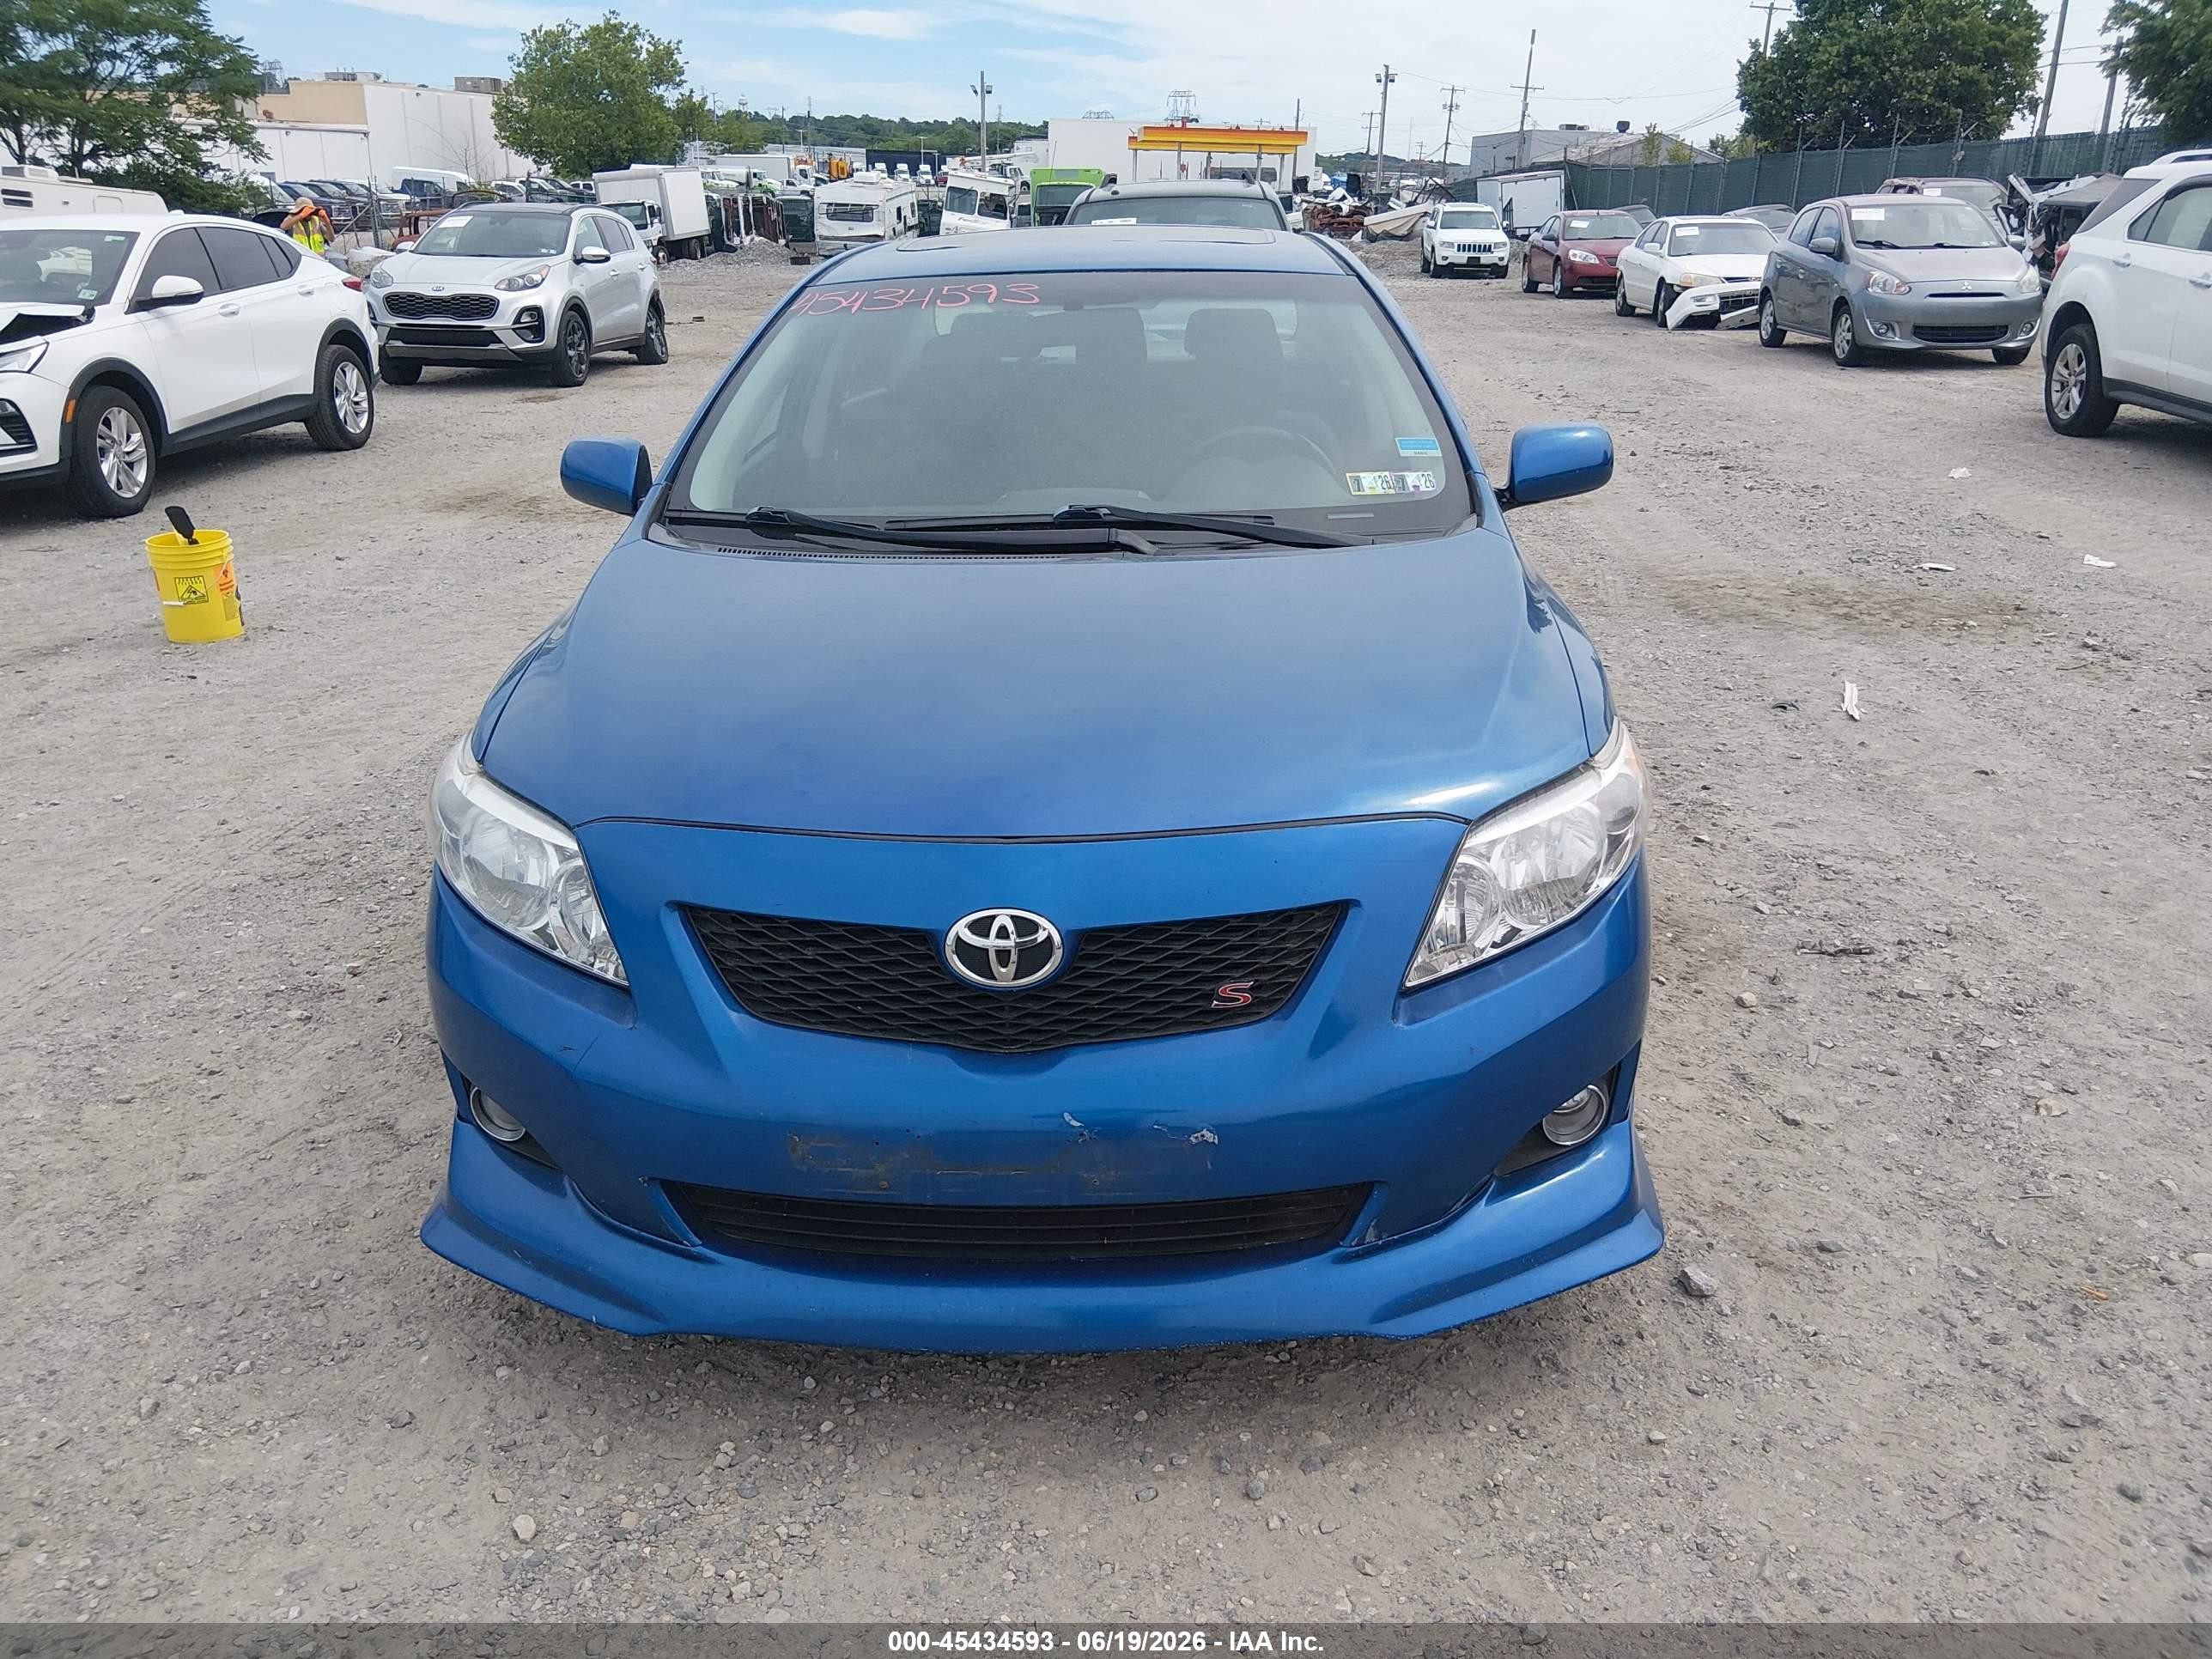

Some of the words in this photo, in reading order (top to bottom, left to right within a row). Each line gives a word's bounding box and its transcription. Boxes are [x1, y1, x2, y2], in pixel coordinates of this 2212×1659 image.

[790, 283, 1041, 317] 45434593
[1377, 474, 1392, 490] 26
[1421, 473, 1435, 489] 26
[1210, 981, 1254, 1009] S
